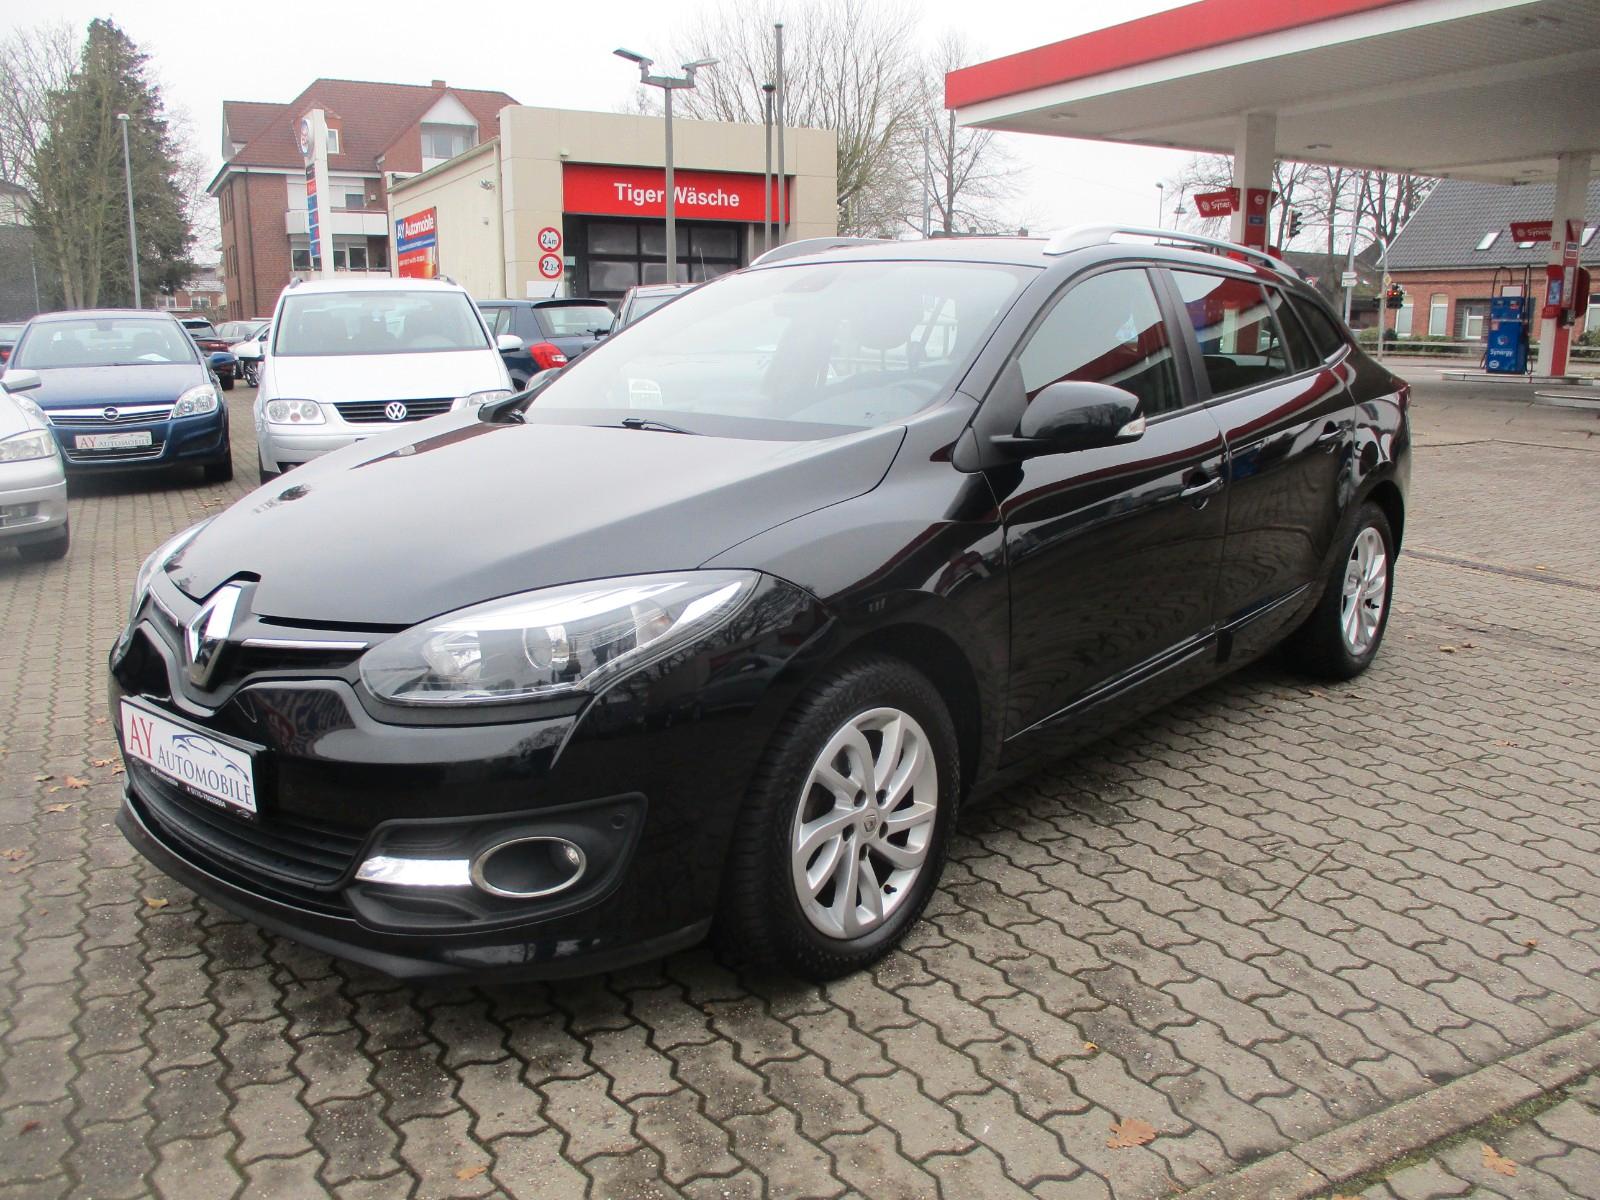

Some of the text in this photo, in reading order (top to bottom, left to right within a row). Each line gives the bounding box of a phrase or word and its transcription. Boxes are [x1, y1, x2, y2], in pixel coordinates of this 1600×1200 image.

[614, 182, 740, 207] Tiger Wäsche
[397, 214, 434, 240] AY Automobile
[80, 437, 97, 448] AY
[130, 713, 155, 761] AY
[158, 744, 253, 806] AUTOMOBILE
